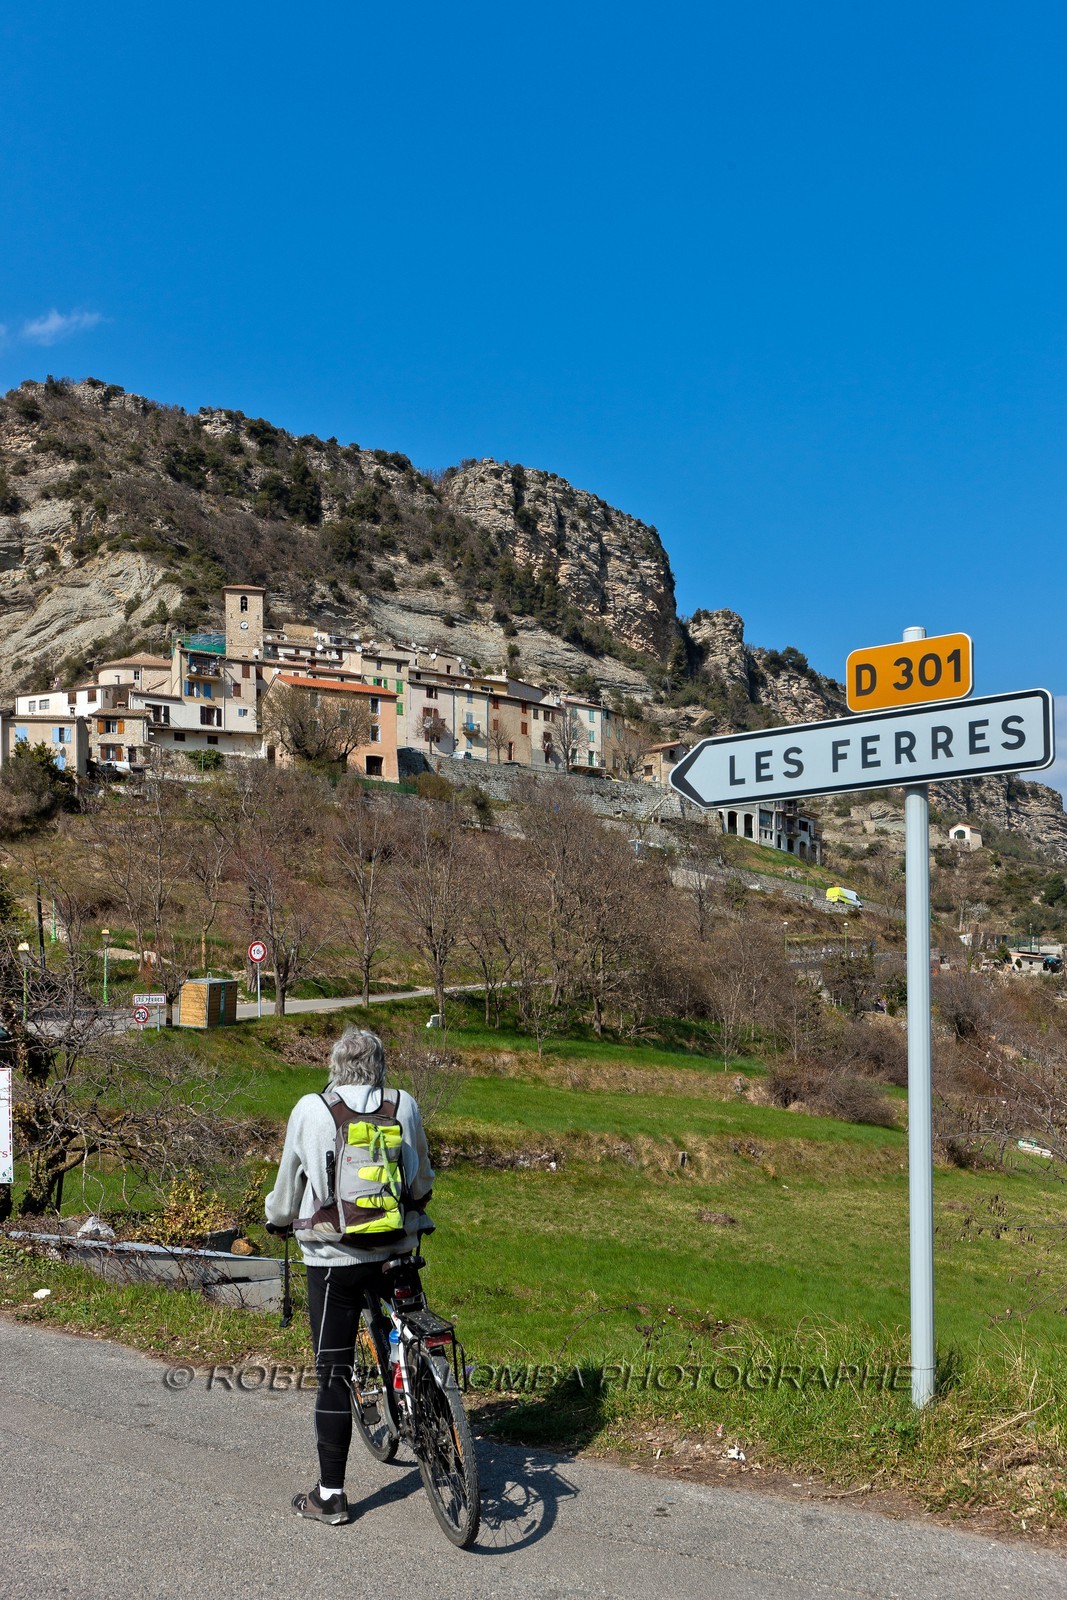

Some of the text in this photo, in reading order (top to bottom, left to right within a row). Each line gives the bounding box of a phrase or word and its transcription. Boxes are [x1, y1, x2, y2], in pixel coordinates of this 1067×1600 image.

[855, 648, 961, 697] D 301
[729, 715, 1026, 786] LES FERRES
